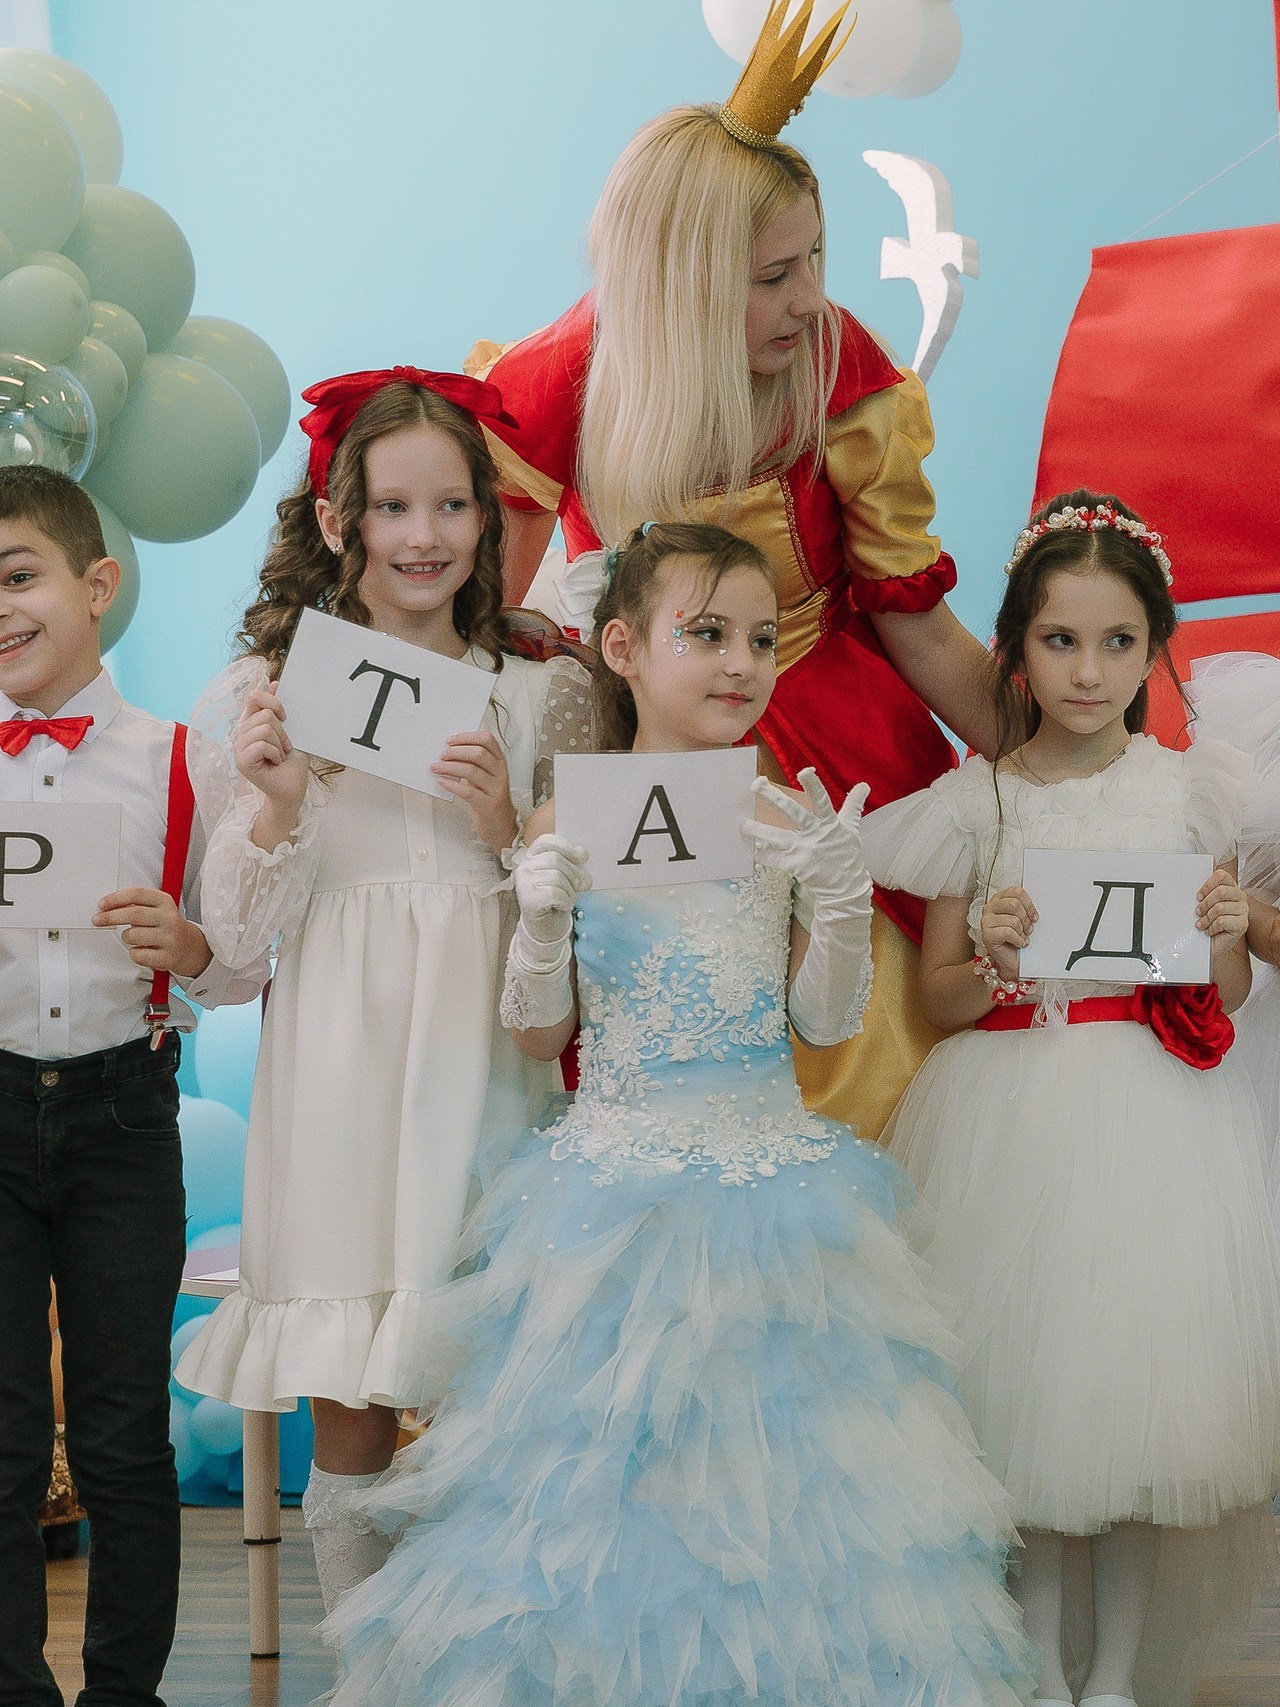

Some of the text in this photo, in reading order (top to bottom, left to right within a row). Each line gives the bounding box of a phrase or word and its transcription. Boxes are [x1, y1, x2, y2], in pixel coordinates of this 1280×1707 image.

[349, 658, 421, 752] Т
[616, 784, 697, 866] А
[0, 831, 54, 907] Р
[1064, 880, 1157, 972] Д
